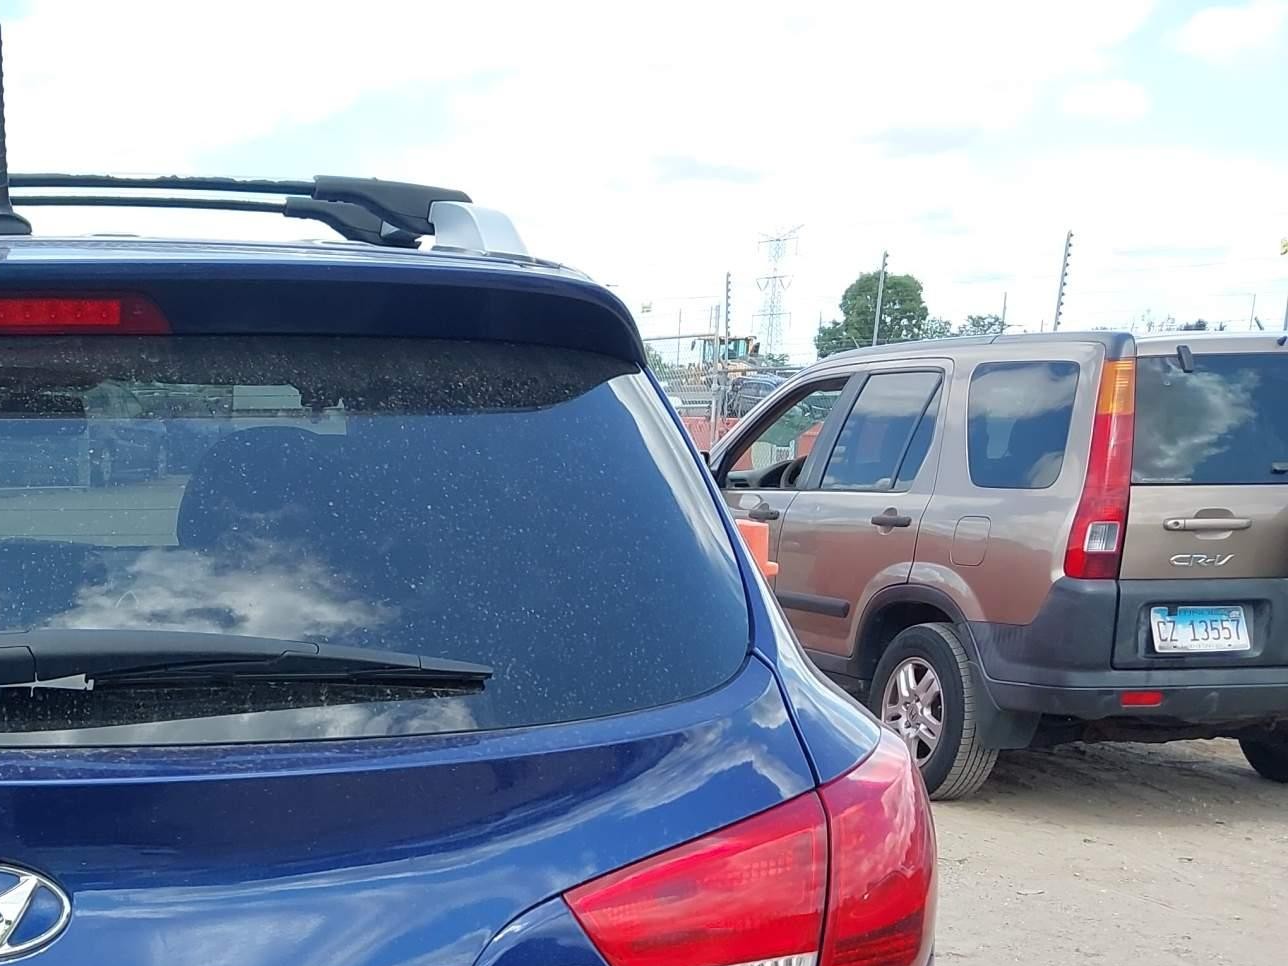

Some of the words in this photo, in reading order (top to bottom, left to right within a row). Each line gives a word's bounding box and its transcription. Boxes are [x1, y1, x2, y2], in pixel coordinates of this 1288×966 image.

[1169, 554, 1235, 567] CR-V
[1156, 620, 1179, 642] CZ
[1188, 619, 1241, 642] 13557
